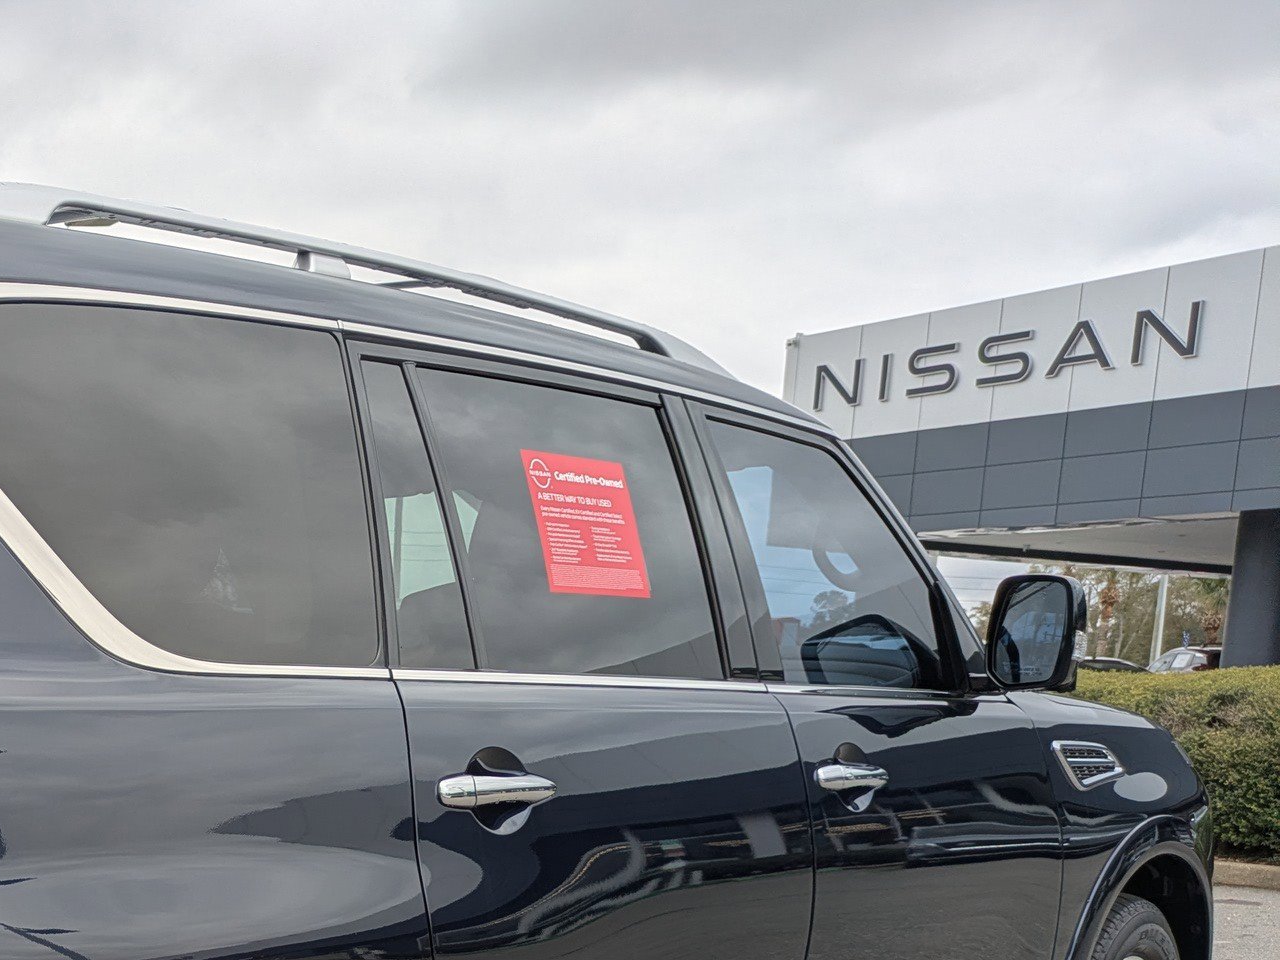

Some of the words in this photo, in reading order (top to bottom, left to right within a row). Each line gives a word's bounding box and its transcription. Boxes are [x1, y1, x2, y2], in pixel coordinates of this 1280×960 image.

[812, 299, 1205, 412] NISSAN
[553, 470, 584, 483] Certified
[584, 474, 624, 488] Pre-Owned
[543, 492, 565, 502] BETTER
[597, 498, 612, 507] USED
